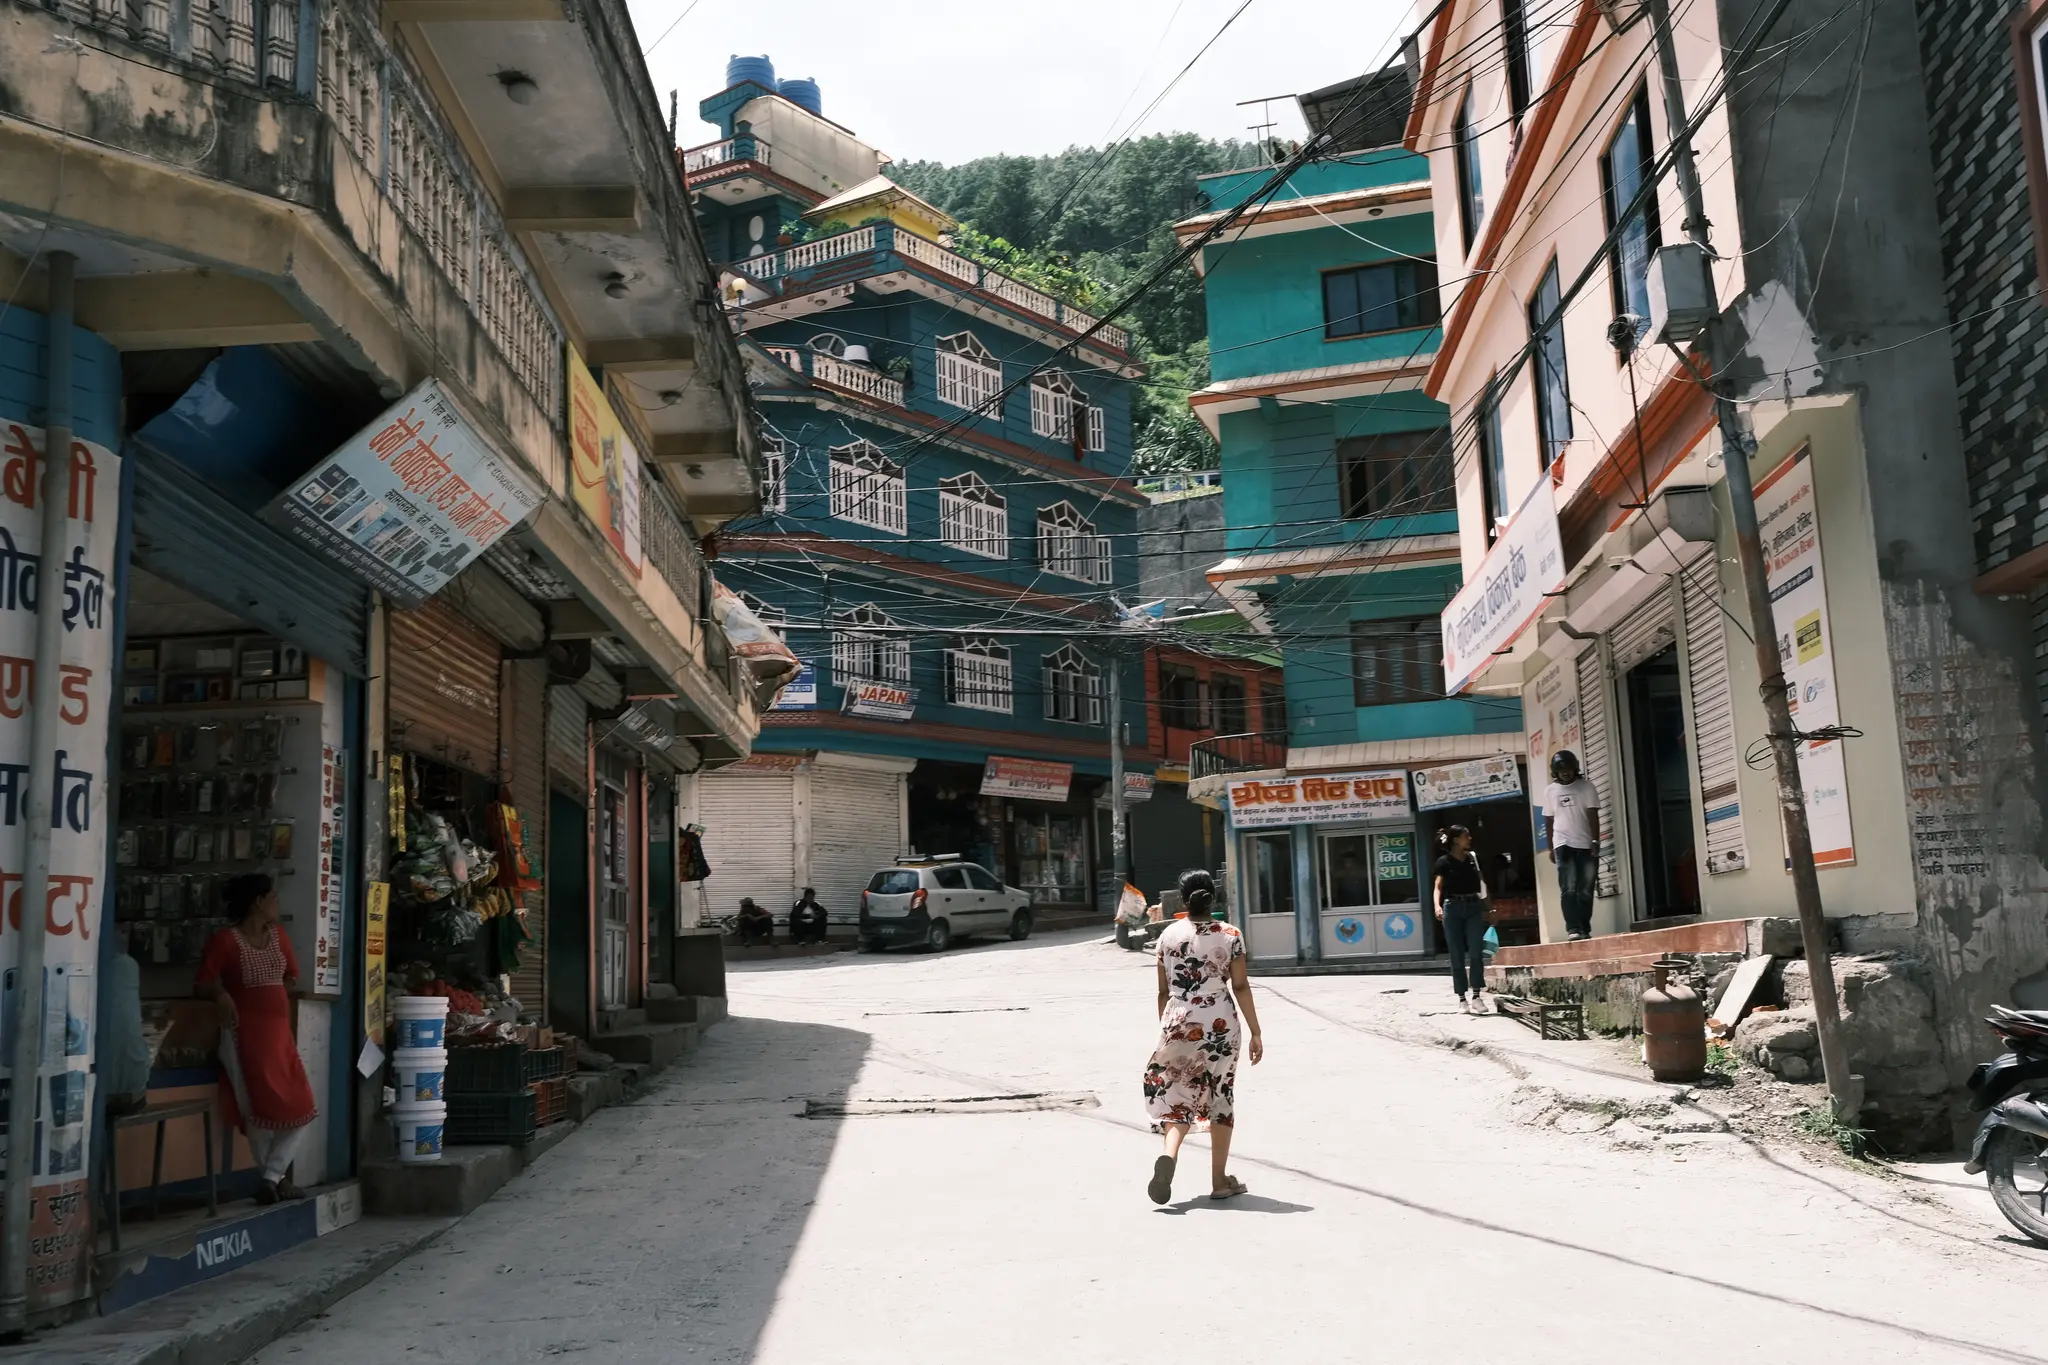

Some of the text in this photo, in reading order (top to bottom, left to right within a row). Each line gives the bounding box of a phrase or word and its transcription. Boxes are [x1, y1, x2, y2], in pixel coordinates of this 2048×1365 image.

[1485, 565, 1513, 620] विकास
[860, 687, 909, 704] JAPAN
[1301, 778, 1351, 801] मिट
[1380, 850, 1408, 863] मिट
[196, 1228, 253, 1269] NOKIA
